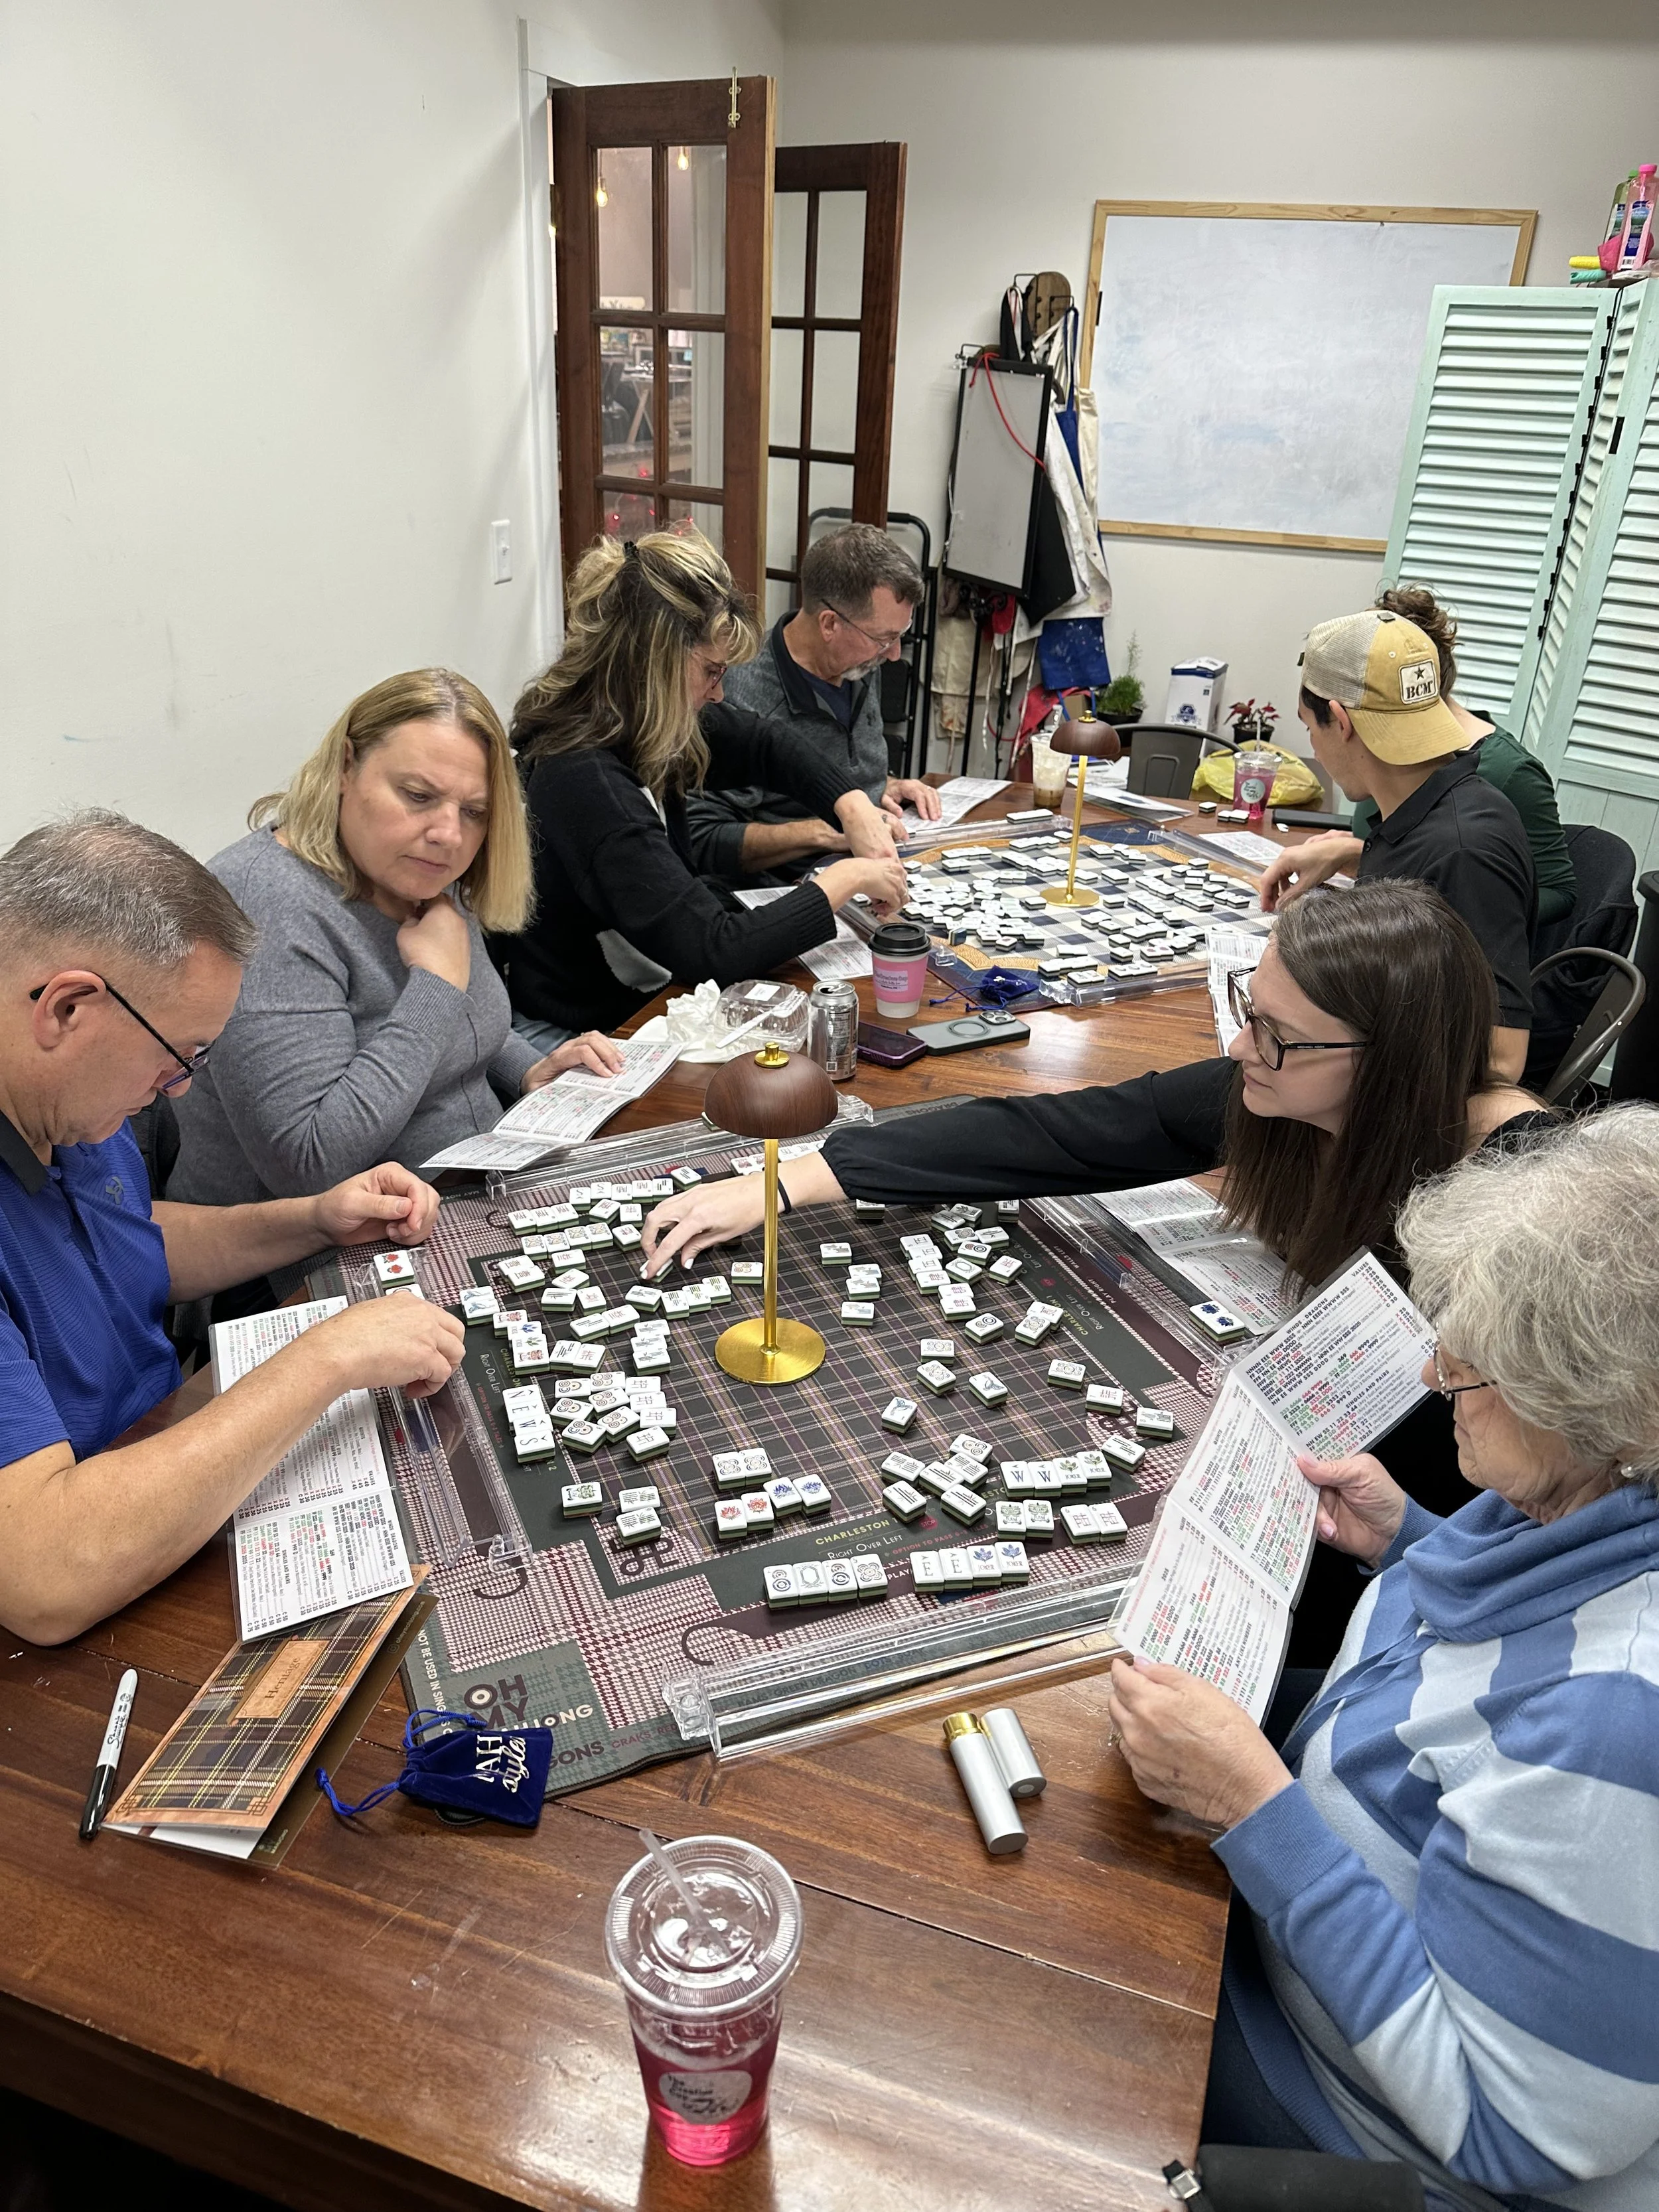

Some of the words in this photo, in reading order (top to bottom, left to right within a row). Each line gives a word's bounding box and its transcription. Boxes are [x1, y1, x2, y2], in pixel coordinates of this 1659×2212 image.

[1406, 681, 1433, 699] BCM
[905, 1101, 959, 1116] DRAGONS
[1054, 1245, 1064, 1256] LEFT
[1063, 1255, 1079, 1269] WALLS
[1351, 1260, 1369, 1277] VALUES
[1087, 1279, 1104, 1293] RIGHT
[1066, 1293, 1078, 1304] LEFT
[1102, 1293, 1116, 1304] PLAY
[1075, 1303, 1090, 1317] OVER
[1286, 1319, 1302, 1334] WINDS
[1303, 1297, 1329, 1319] DRAGONS
[1088, 1316, 1104, 1331] RIGHT
[1246, 1361, 1262, 1375] NNNN
[1260, 1354, 1270, 1363] EEE
[1269, 1342, 1284, 1356] WWW
[1283, 1332, 1296, 1344] SSSS
[1301, 1317, 1313, 1329] NNN
[1322, 1293, 1341, 1311] WWWW
[1339, 1286, 1350, 1295] SSS
[480, 1353, 490, 1368] RIGHT
[1253, 1375, 1262, 1384] FFF
[1261, 1368, 1270, 1377] NN
[1275, 1351, 1291, 1365] WWW
[1289, 1341, 1303, 1353] SSSS
[1256, 1365, 1265, 1374] 123
[1271, 1350, 1283, 1361] DDD
[1282, 1339, 1297, 1353] DDDD
[1277, 1358, 1291, 1371] NEWS
[486, 1368, 496, 1382] OVER
[1271, 1397, 1281, 1406] NN
[1287, 1378, 1303, 1392] WWW
[1302, 1369, 1313, 1380] SSS
[1313, 1357, 1329, 1371] DDDD
[1284, 1370, 1295, 1380] 222
[490, 1382, 500, 1394] LEFT
[1305, 1439, 1315, 1448] NN
[1314, 1432, 1323, 1441] EW
[1321, 1426, 1330, 1435] SS
[1424, 1337, 1433, 1346] 50
[1344, 1390, 1366, 1409] SINGLES
[1364, 1381, 1376, 1392] AND
[1375, 1368, 1390, 1382] PAIRS
[1267, 1392, 1276, 1401] NN
[1335, 1393, 1346, 1404] 999
[512, 1405, 529, 1414] E
[519, 1419, 536, 1428] W
[520, 1437, 538, 1445] S
[1358, 1428, 1373, 1441] 2025
[1011, 1471, 1025, 1483] W
[1038, 1471, 1052, 1483] W
[920, 1518, 937, 1530] STOP
[815, 1519, 891, 1546] CHARLESTON
[828, 1548, 854, 1561] RIGHT
[856, 1538, 884, 1553] OVER
[886, 1533, 903, 1546] LEFT
[892, 1542, 920, 1556] OPTION
[921, 1538, 932, 1548] TO
[924, 1562, 933, 1576] E
[951, 1559, 960, 1574] E
[977, 1563, 995, 1572] JOKER
[1006, 1560, 1023, 1568] JOKER
[887, 1570, 910, 1582] PLAY
[417, 1629, 429, 1647] NOT
[421, 1647, 431, 1658] BE
[424, 1658, 438, 1680] USED
[264, 1656, 301, 1701] Heritage
[430, 1680, 440, 1690] IN
[465, 1674, 528, 1710] OH
[472, 1695, 529, 1730] MY
[611, 1731, 652, 1749] CRAKS
